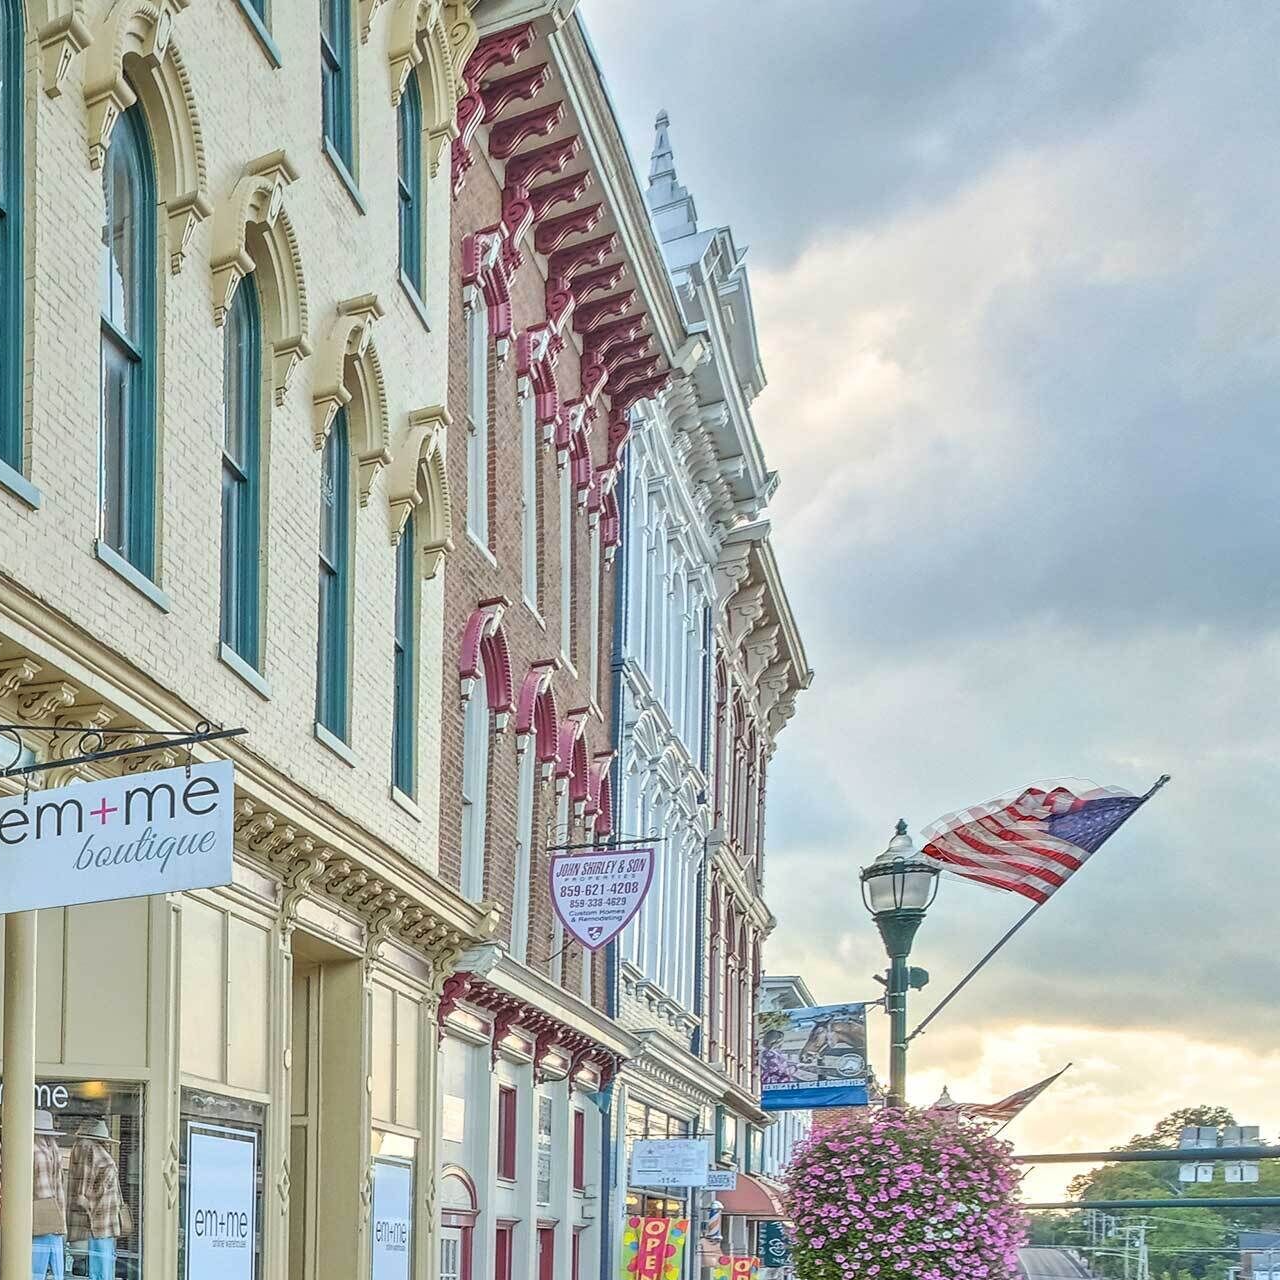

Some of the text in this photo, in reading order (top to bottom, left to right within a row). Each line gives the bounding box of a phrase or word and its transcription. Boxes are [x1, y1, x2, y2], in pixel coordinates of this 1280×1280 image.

[73, 827, 216, 873] boutique
[556, 858, 647, 877] JOHN SHIRLEY & SON
[560, 882, 639, 897] 859-621-4208
[195, 1209, 248, 1238] em+me
